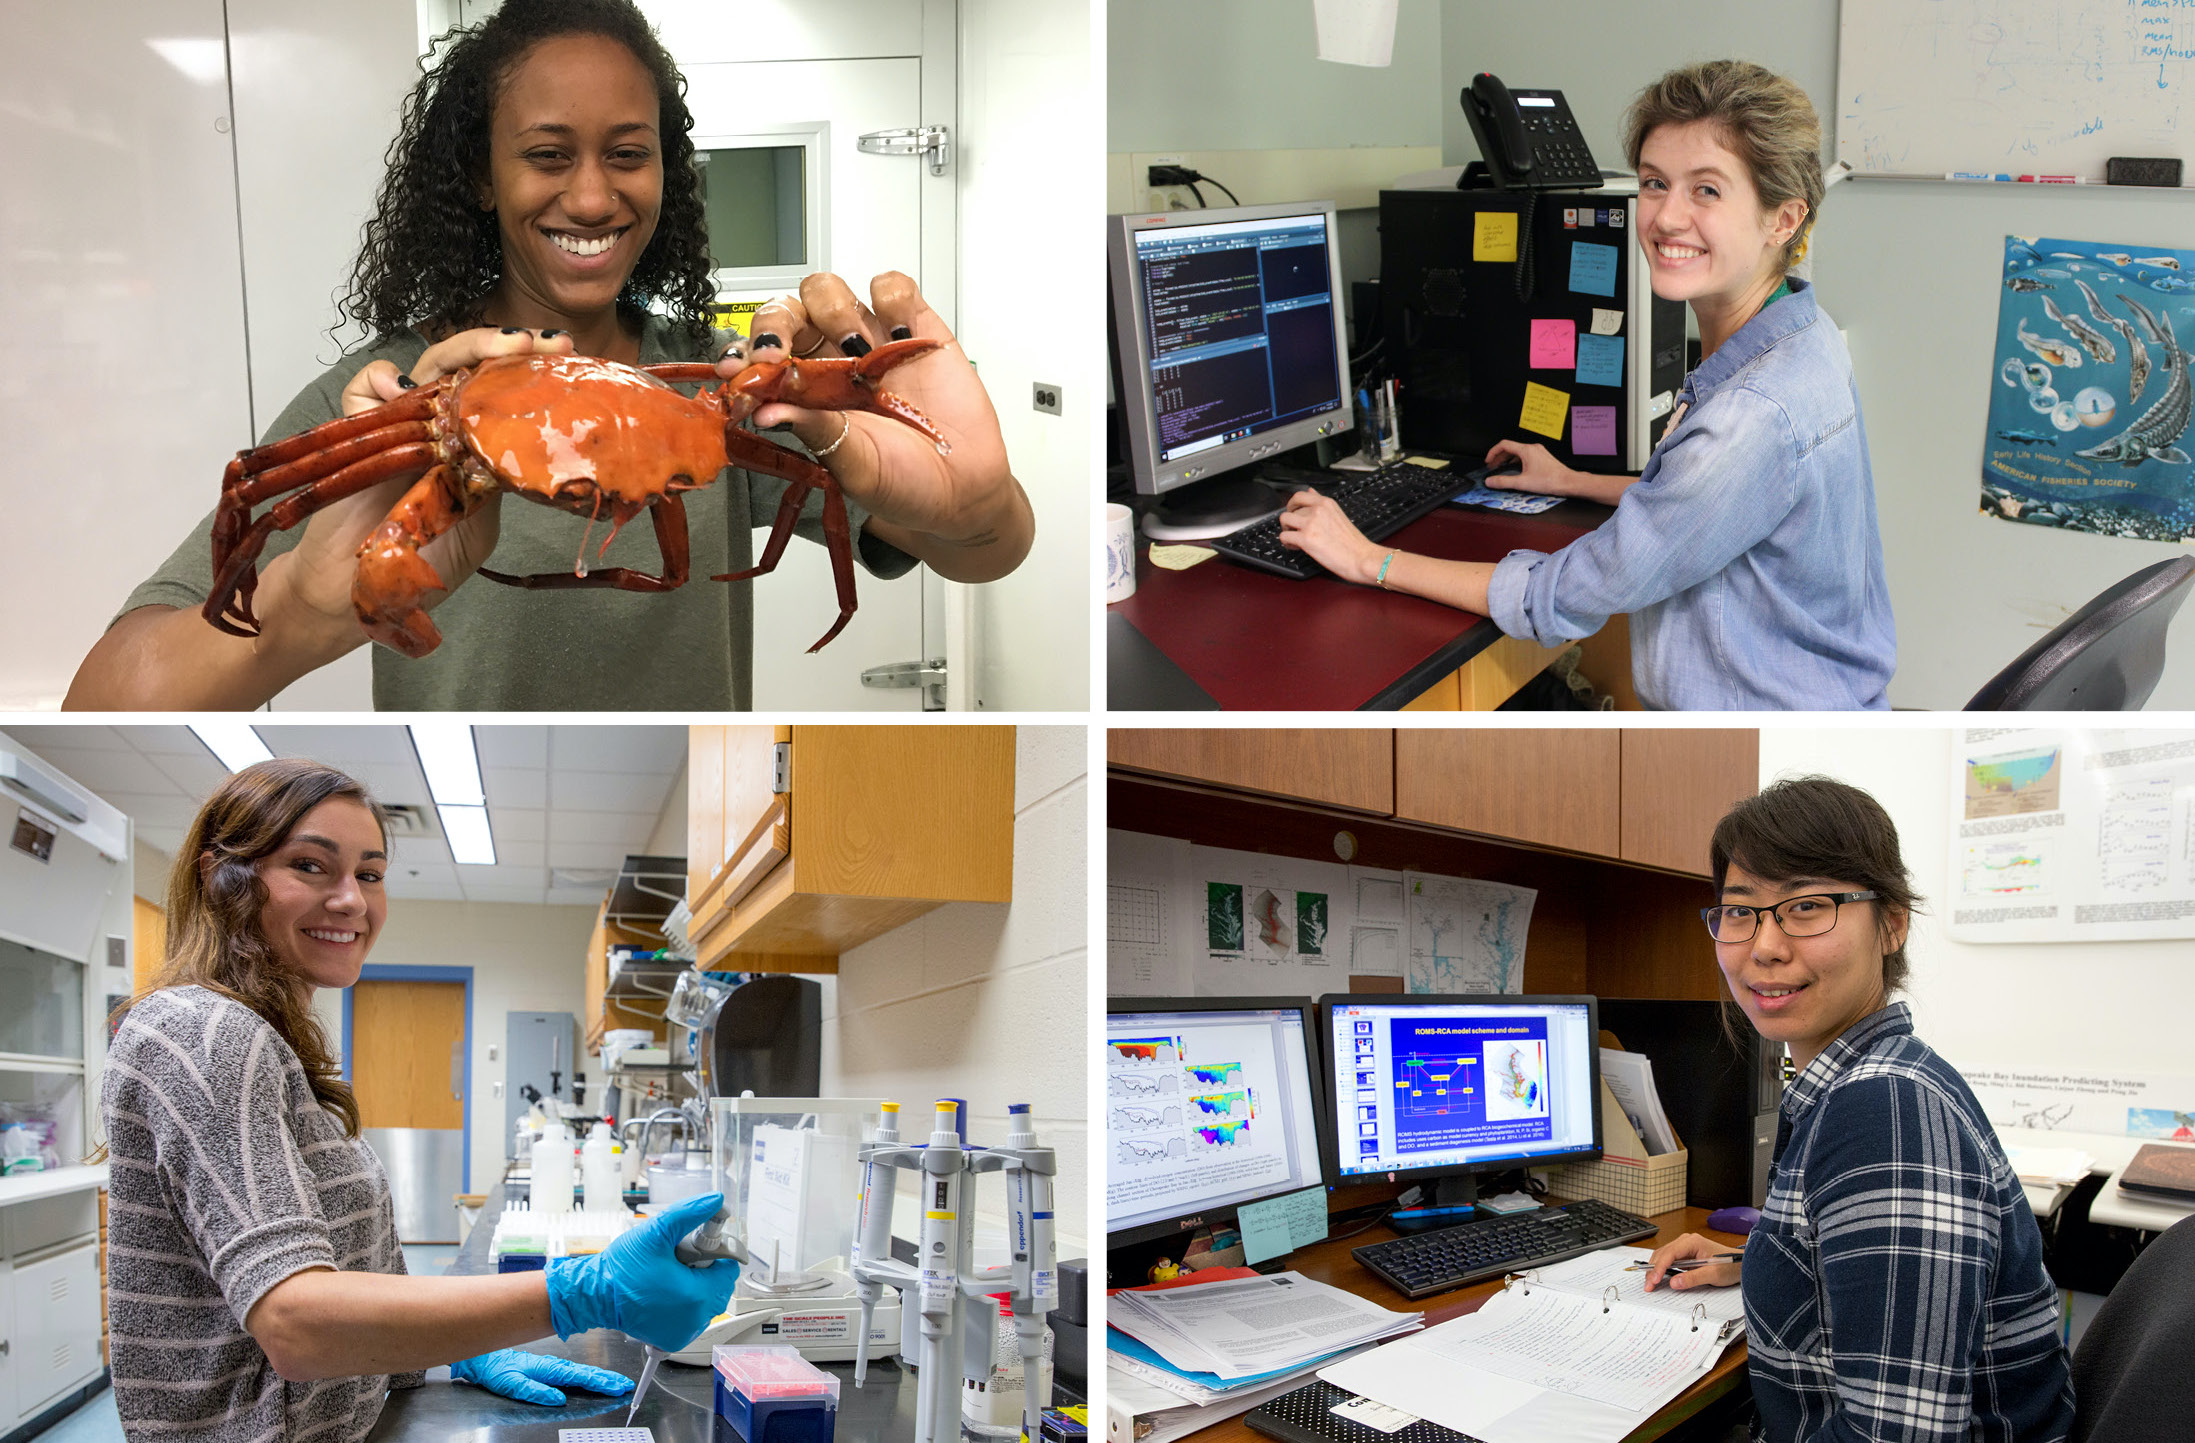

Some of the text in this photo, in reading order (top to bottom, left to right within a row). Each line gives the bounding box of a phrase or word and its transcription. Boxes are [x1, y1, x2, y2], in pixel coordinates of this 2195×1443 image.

[731, 304, 762, 312] CAUTI
[1994, 450, 2092, 476] Early Life History Section
[1991, 459, 2137, 489] AMERICAN FISHERIES SOCIETY
[1452, 1027, 1471, 1035] model
[1507, 1026, 1529, 1034] domain
[1994, 1072, 2009, 1080] Bay
[2012, 1073, 2059, 1082] Inundation
[2062, 1075, 2109, 1088] Predicting
[2112, 1079, 2146, 1088] System
[1017, 1211, 1026, 1250] eppendorf
[1180, 1217, 1204, 1230] DELL
